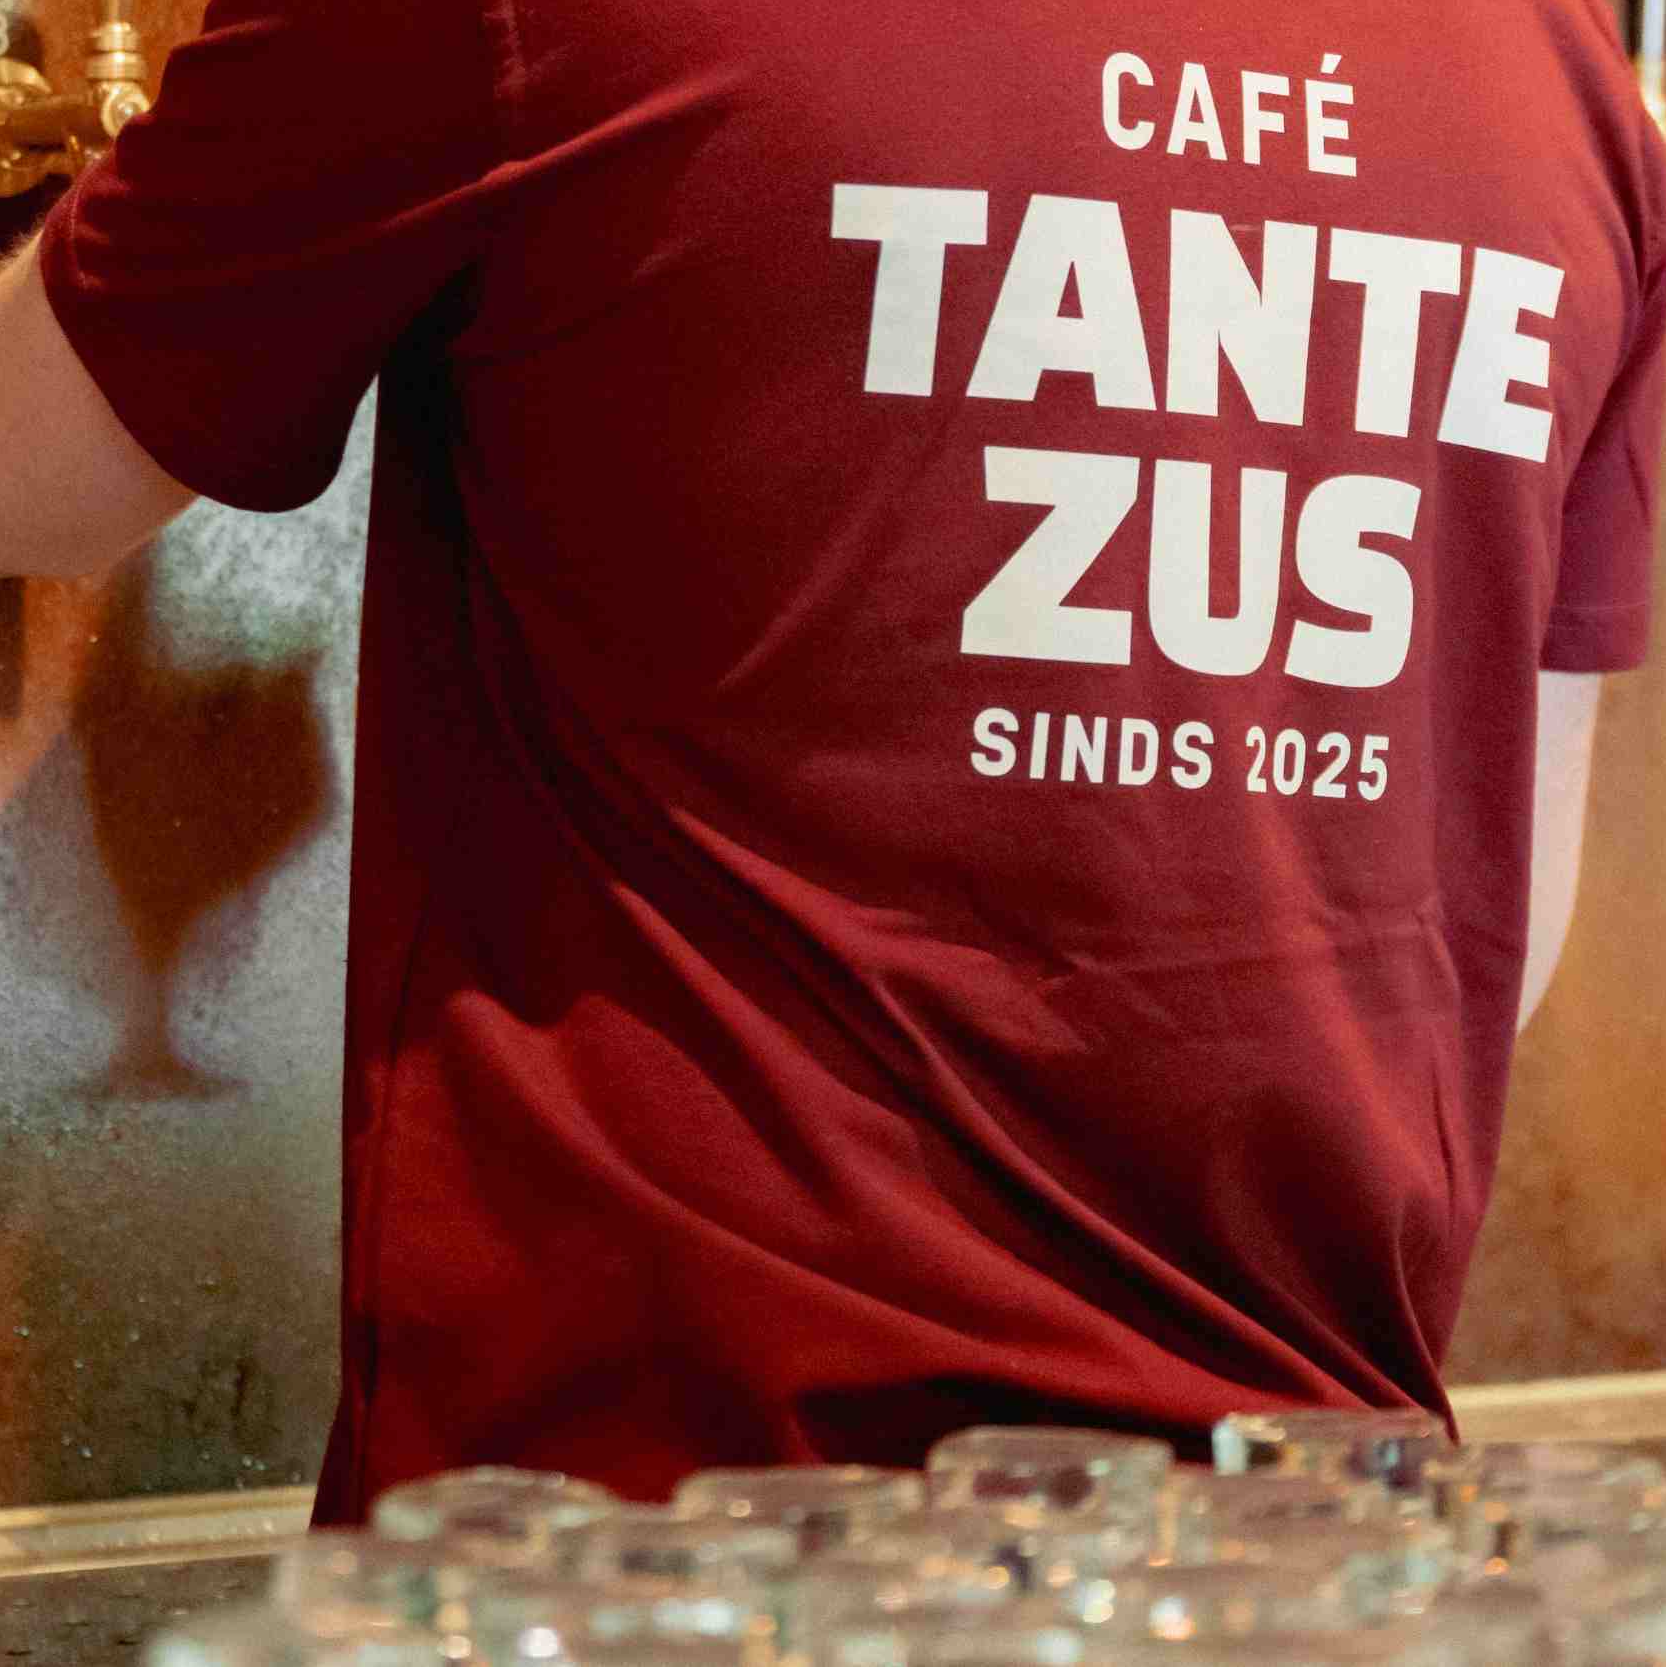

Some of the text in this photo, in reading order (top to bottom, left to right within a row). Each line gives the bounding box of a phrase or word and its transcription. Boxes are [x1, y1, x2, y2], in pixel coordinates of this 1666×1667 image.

[1101, 51, 1357, 177] CAFÉ
[831, 183, 1565, 464] TANTE
[960, 445, 1422, 689] ZUS
[970, 707, 1391, 801] SINDS 2025
